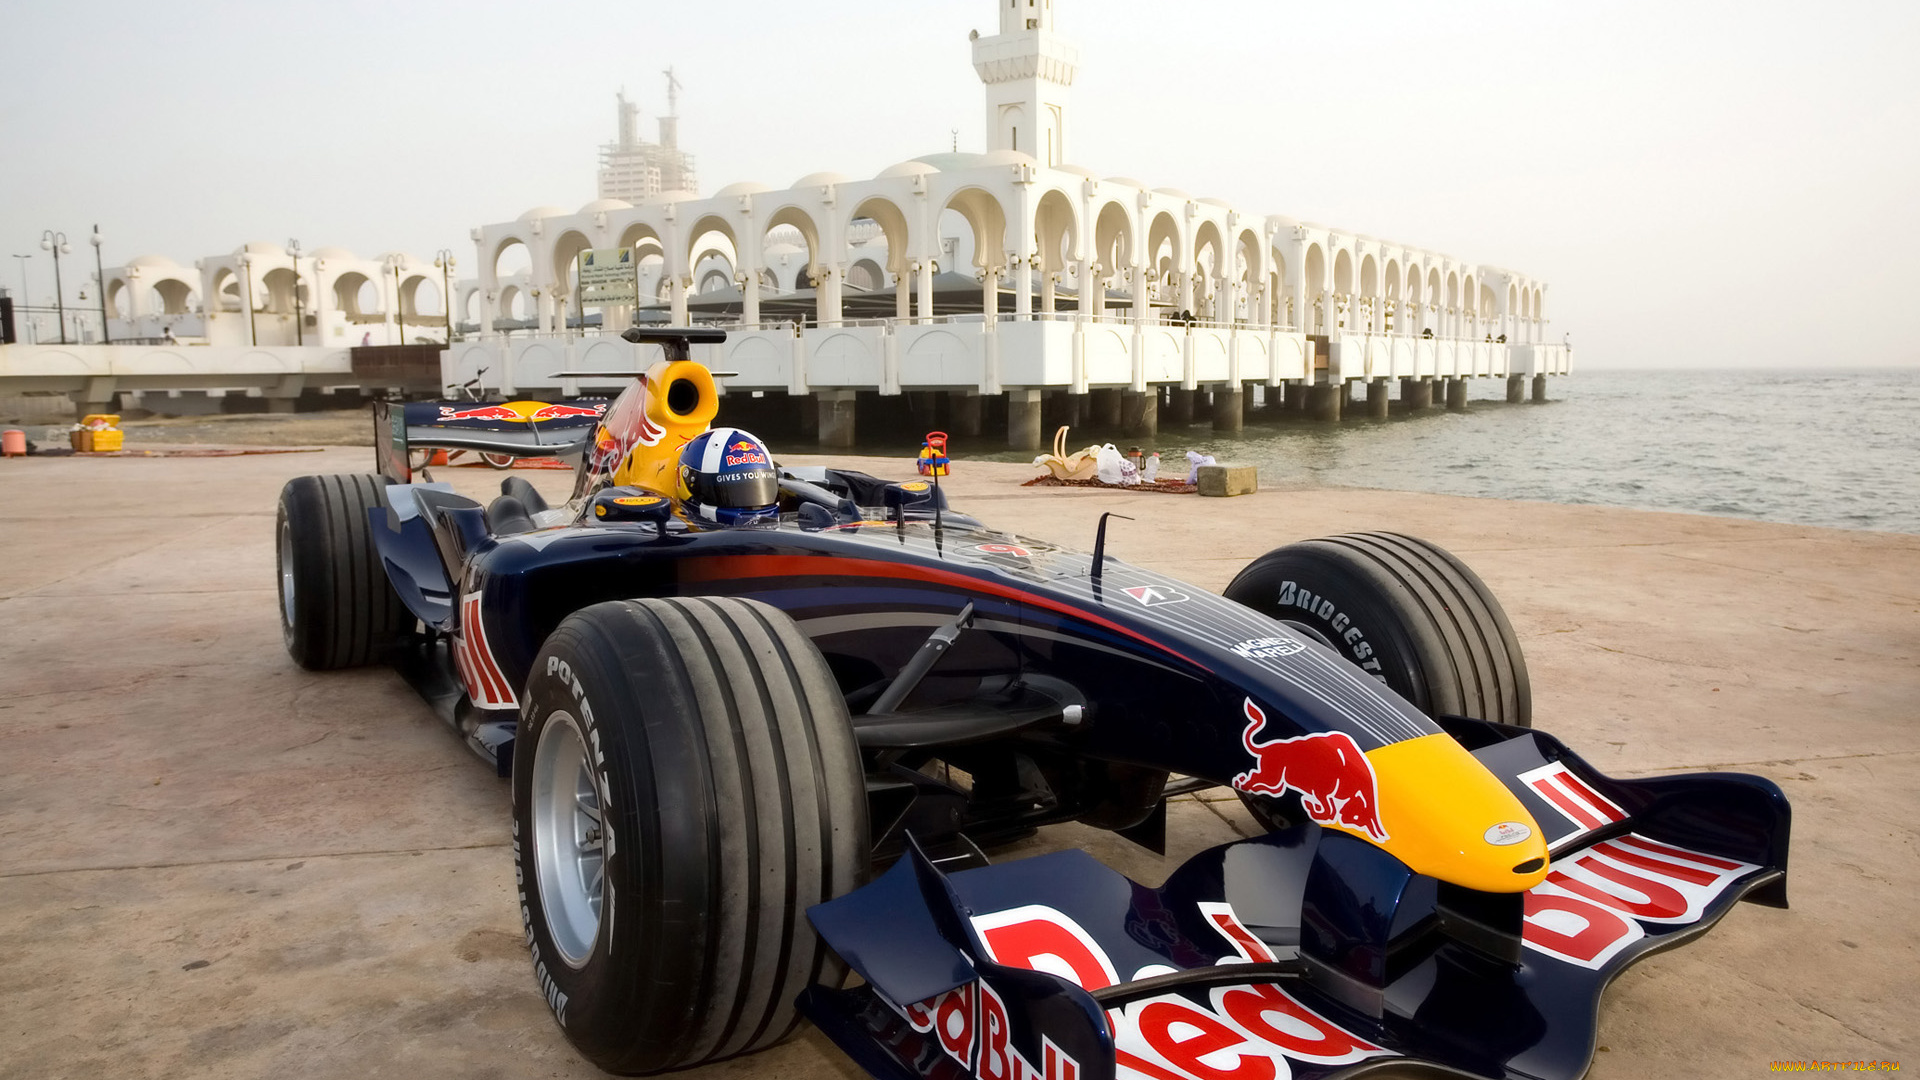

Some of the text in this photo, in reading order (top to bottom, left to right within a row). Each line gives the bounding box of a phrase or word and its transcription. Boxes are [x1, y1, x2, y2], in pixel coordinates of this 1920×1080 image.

[716, 473, 741, 483] GIVES
[743, 472, 759, 480] YOU
[726, 453, 766, 467] Red Bull
[1278, 581, 1388, 687] BRIDGEST
[547, 656, 616, 861] POTENZA
